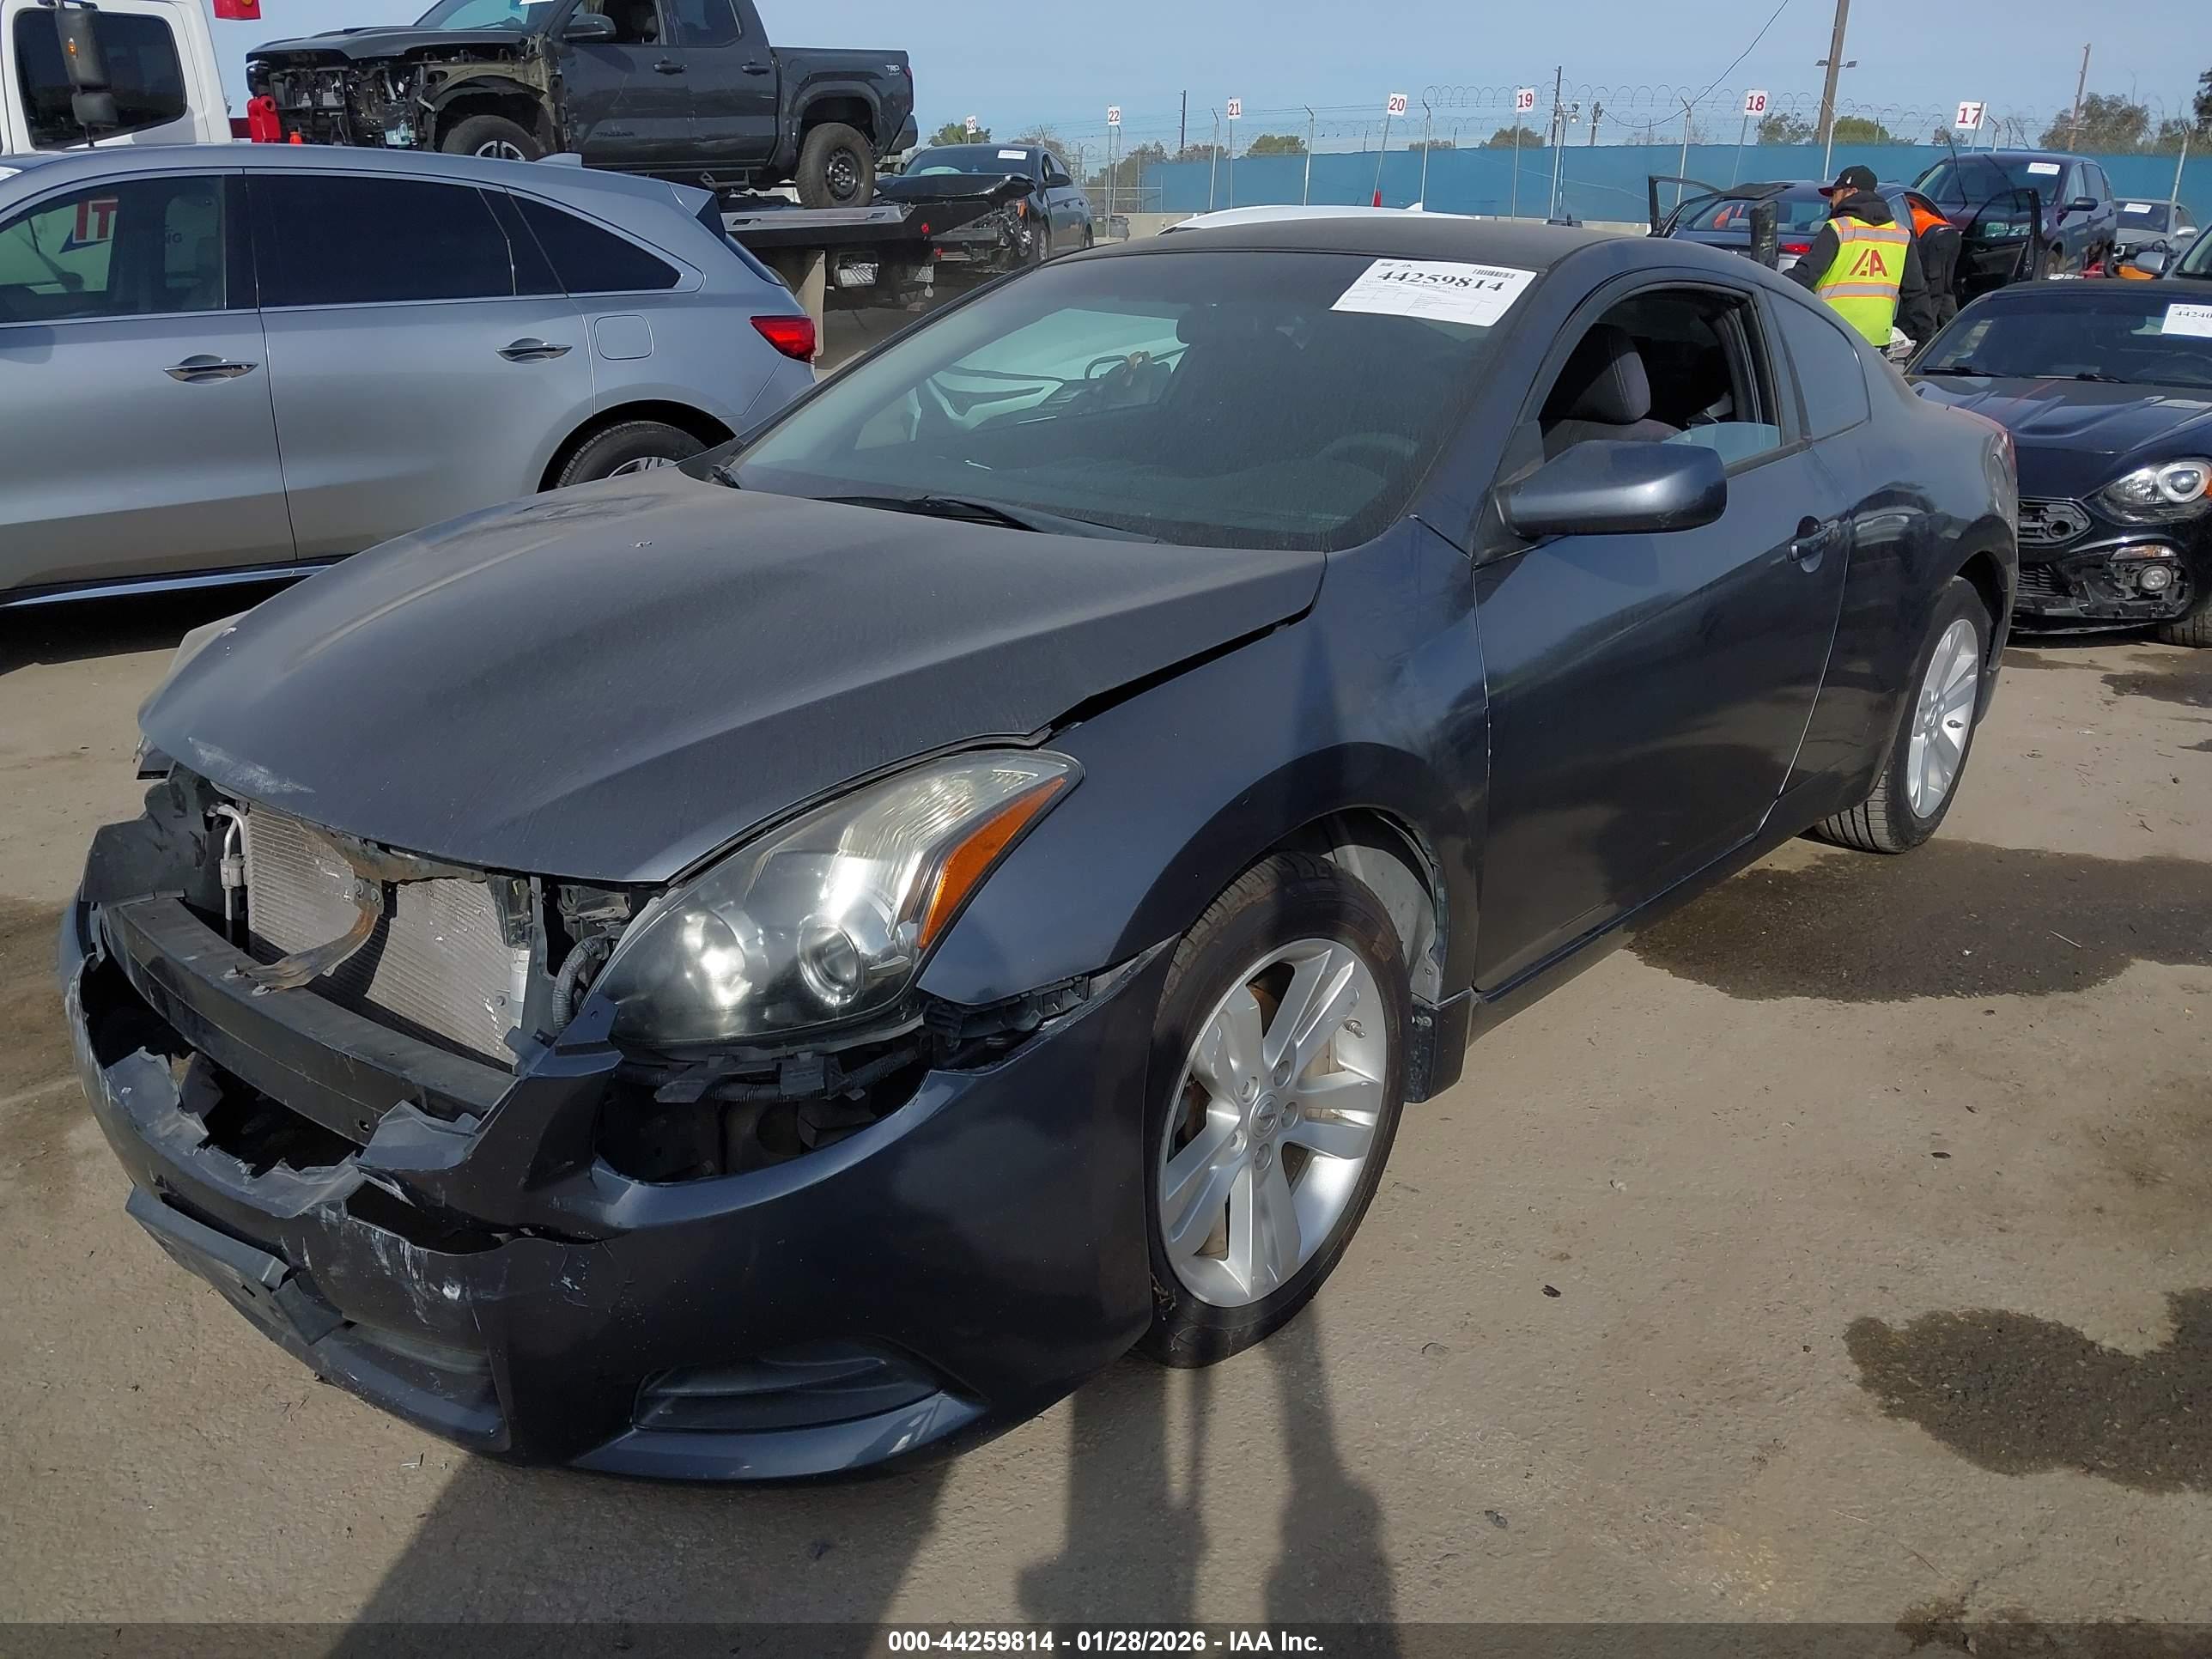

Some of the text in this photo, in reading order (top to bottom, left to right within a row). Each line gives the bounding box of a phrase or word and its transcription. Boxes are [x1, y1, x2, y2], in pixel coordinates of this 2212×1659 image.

[1389, 97, 1406, 112] 20
[1517, 93, 1533, 107] 19
[1746, 95, 1765, 111] 18
[1109, 110, 1120, 122] 22
[1229, 102, 1240, 116] 21
[1958, 106, 1982, 124] 17
[967, 119, 975, 131] 23
[1377, 270, 1504, 291] 44259814
